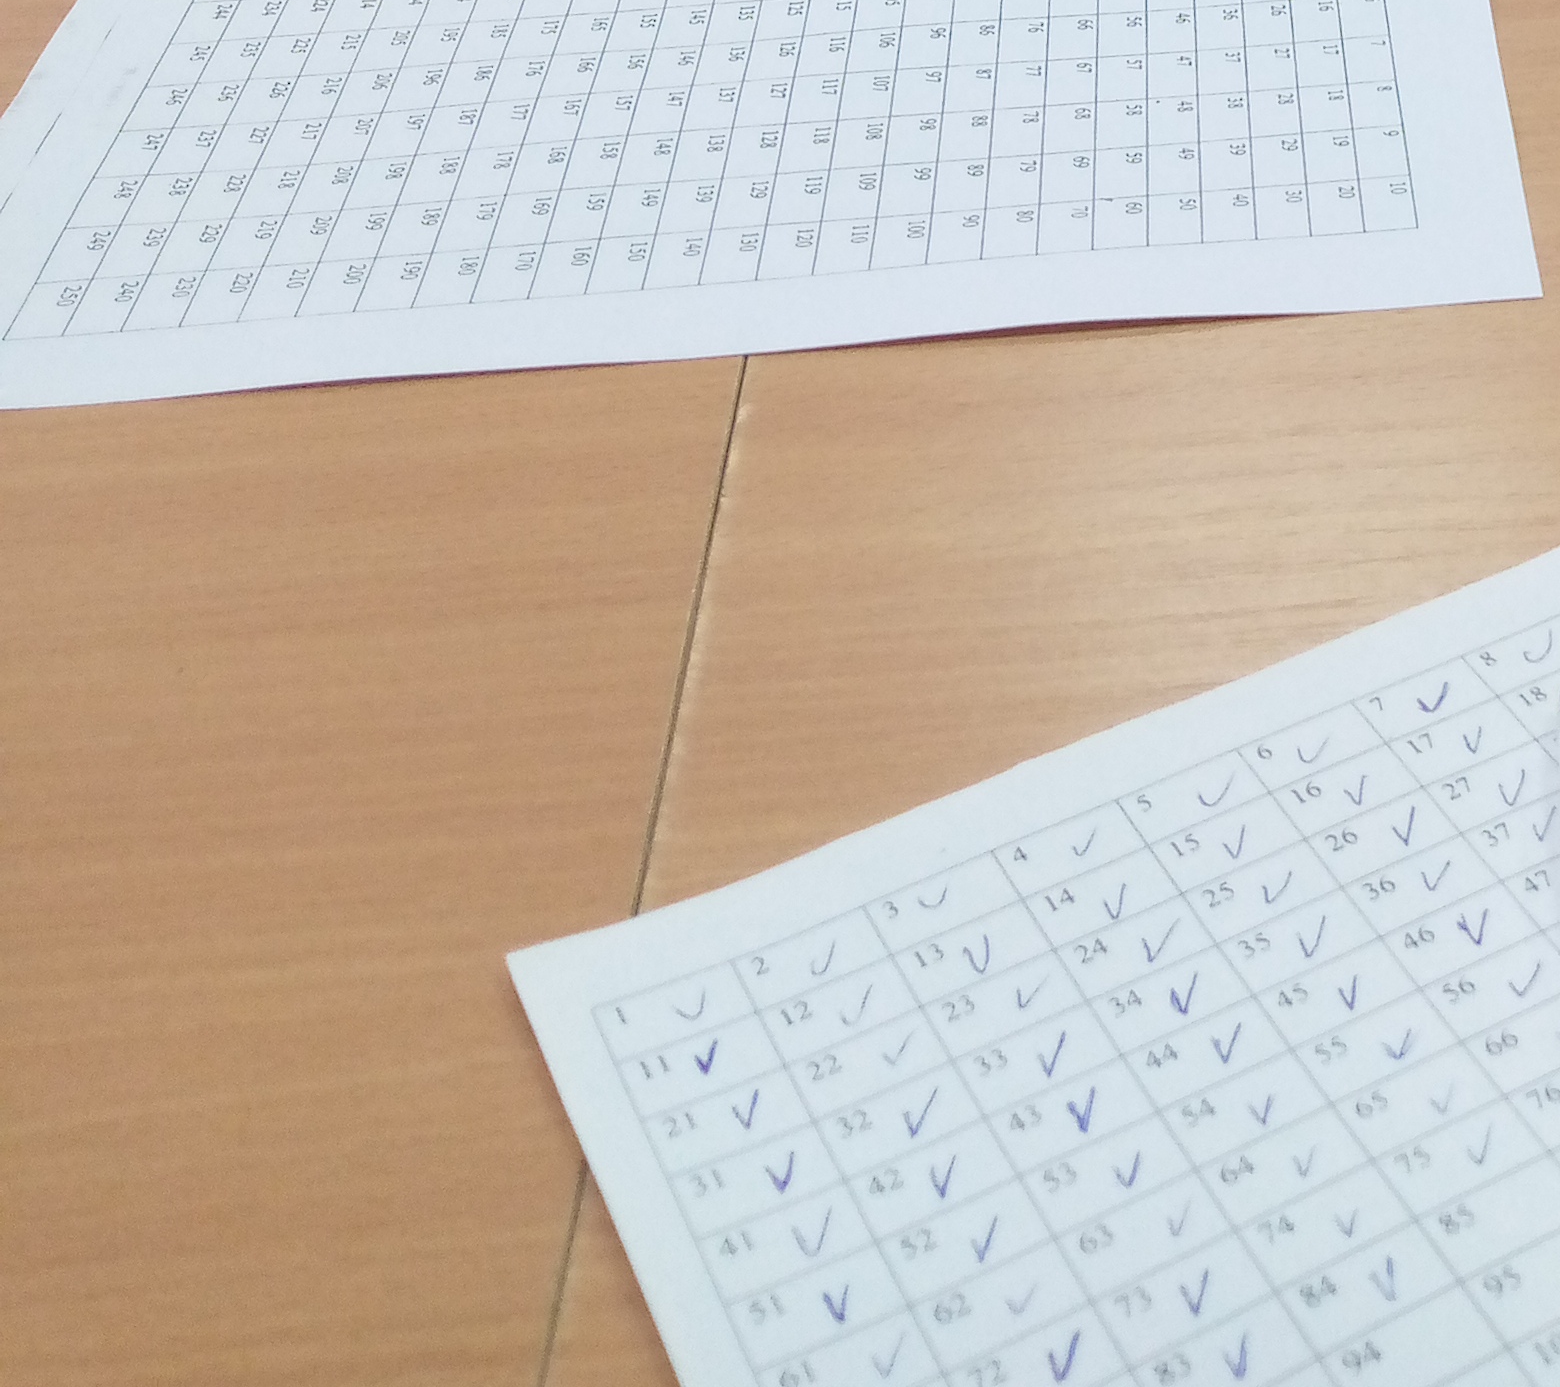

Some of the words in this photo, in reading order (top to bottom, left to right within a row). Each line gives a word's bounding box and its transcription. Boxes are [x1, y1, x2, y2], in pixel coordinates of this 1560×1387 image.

[212, 3, 233, 20] 244
[786, 0, 805, 16] 125
[1317, 0, 1334, 12] 16
[591, 16, 609, 31] 165
[1076, 18, 1094, 30] 66
[339, 33, 362, 50] 215
[778, 41, 797, 57] 126
[1322, 43, 1338, 54] 17
[188, 45, 211, 61] 245
[576, 56, 596, 73] 166
[1075, 61, 1092, 73] 67
[320, 76, 343, 95] 216
[769, 82, 788, 99] 127
[164, 87, 189, 105] 246
[1327, 89, 1344, 101] 18
[562, 98, 582, 116] 167
[1073, 106, 1091, 120] 68
[300, 122, 323, 140] 217
[759, 129, 779, 149] 128
[141, 132, 164, 150] 247
[1331, 134, 1350, 147] 19
[546, 145, 568, 164] 168
[1072, 155, 1090, 168] 69
[276, 169, 301, 189] 218
[112, 179, 139, 199] 248
[749, 180, 770, 199] 129
[1337, 185, 1356, 199] 20
[530, 196, 552, 215] 169
[1070, 207, 1089, 219] 70
[253, 219, 278, 239] 219
[85, 230, 112, 251] 249
[738, 232, 760, 252] 130
[513, 250, 537, 271] 170
[228, 271, 254, 294] 220
[55, 284, 83, 307] 250
[750, 955, 770, 976] 2
[882, 900, 899, 919] 3
[1013, 845, 1028, 861] 4
[1136, 793, 1152, 812] 5
[1256, 744, 1273, 759] 6
[1367, 695, 1384, 711] 7
[1478, 650, 1497, 666] 8
[638, 1054, 670, 1080] 11
[779, 999, 813, 1026] 12
[913, 942, 944, 968] 13
[1043, 887, 1075, 911] 14
[1169, 832, 1200, 857] 15
[1290, 781, 1322, 804] 16
[1406, 731, 1433, 754] 17
[1518, 685, 1547, 707] 18
[661, 1110, 698, 1139] 21
[805, 1051, 843, 1082] 22
[940, 993, 975, 1023] 23
[1073, 937, 1108, 964] 24
[1201, 880, 1234, 908] 25
[1324, 828, 1358, 852] 26
[1441, 775, 1470, 801] 27
[688, 1167, 726, 1197] 31
[835, 1108, 872, 1139] 32
[972, 1047, 1008, 1076] 33
[1107, 988, 1143, 1014] 34
[1236, 931, 1270, 958] 35
[1361, 877, 1396, 900] 36
[1480, 821, 1510, 847] 37
[718, 1229, 754, 1256] 41
[868, 1167, 904, 1195] 42
[1008, 1103, 1042, 1131] 43
[1145, 1042, 1178, 1068] 44
[1277, 982, 1308, 1007] 45
[1403, 926, 1435, 949] 46
[1525, 869, 1551, 891] 47
[747, 1291, 785, 1326] 51
[898, 1226, 937, 1260] 52
[1041, 1160, 1078, 1193] 53
[1179, 1096, 1217, 1128] 54
[1313, 1034, 1348, 1064] 55
[1441, 979, 1476, 1003] 56
